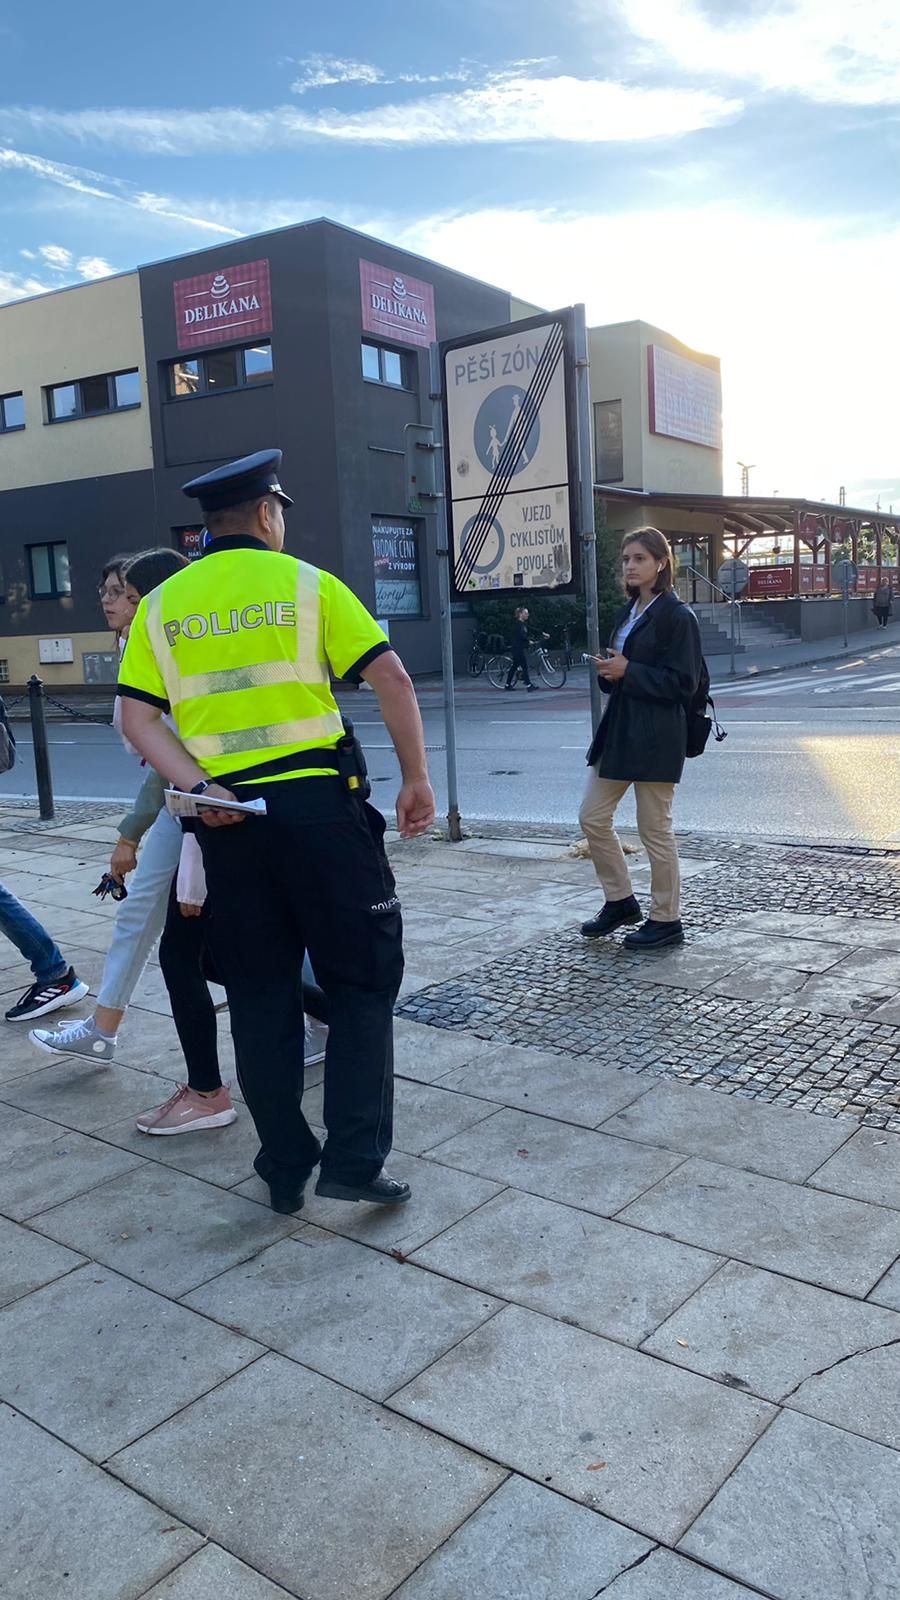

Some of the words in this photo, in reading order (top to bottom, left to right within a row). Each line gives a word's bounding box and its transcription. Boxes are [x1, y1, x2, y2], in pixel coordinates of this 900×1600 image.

[184, 295, 261, 325] DELIKANA
[371, 293, 427, 326] DELIKANA
[455, 350, 496, 386] PĚŠÍ
[501, 342, 546, 375] ZÓN
[521, 504, 552, 523] VJEZD
[405, 528, 414, 536] ZA
[509, 523, 565, 548] CYKLISTŮM
[393, 560, 415, 570] VÝROBY
[163, 601, 296, 647] POLICIE
